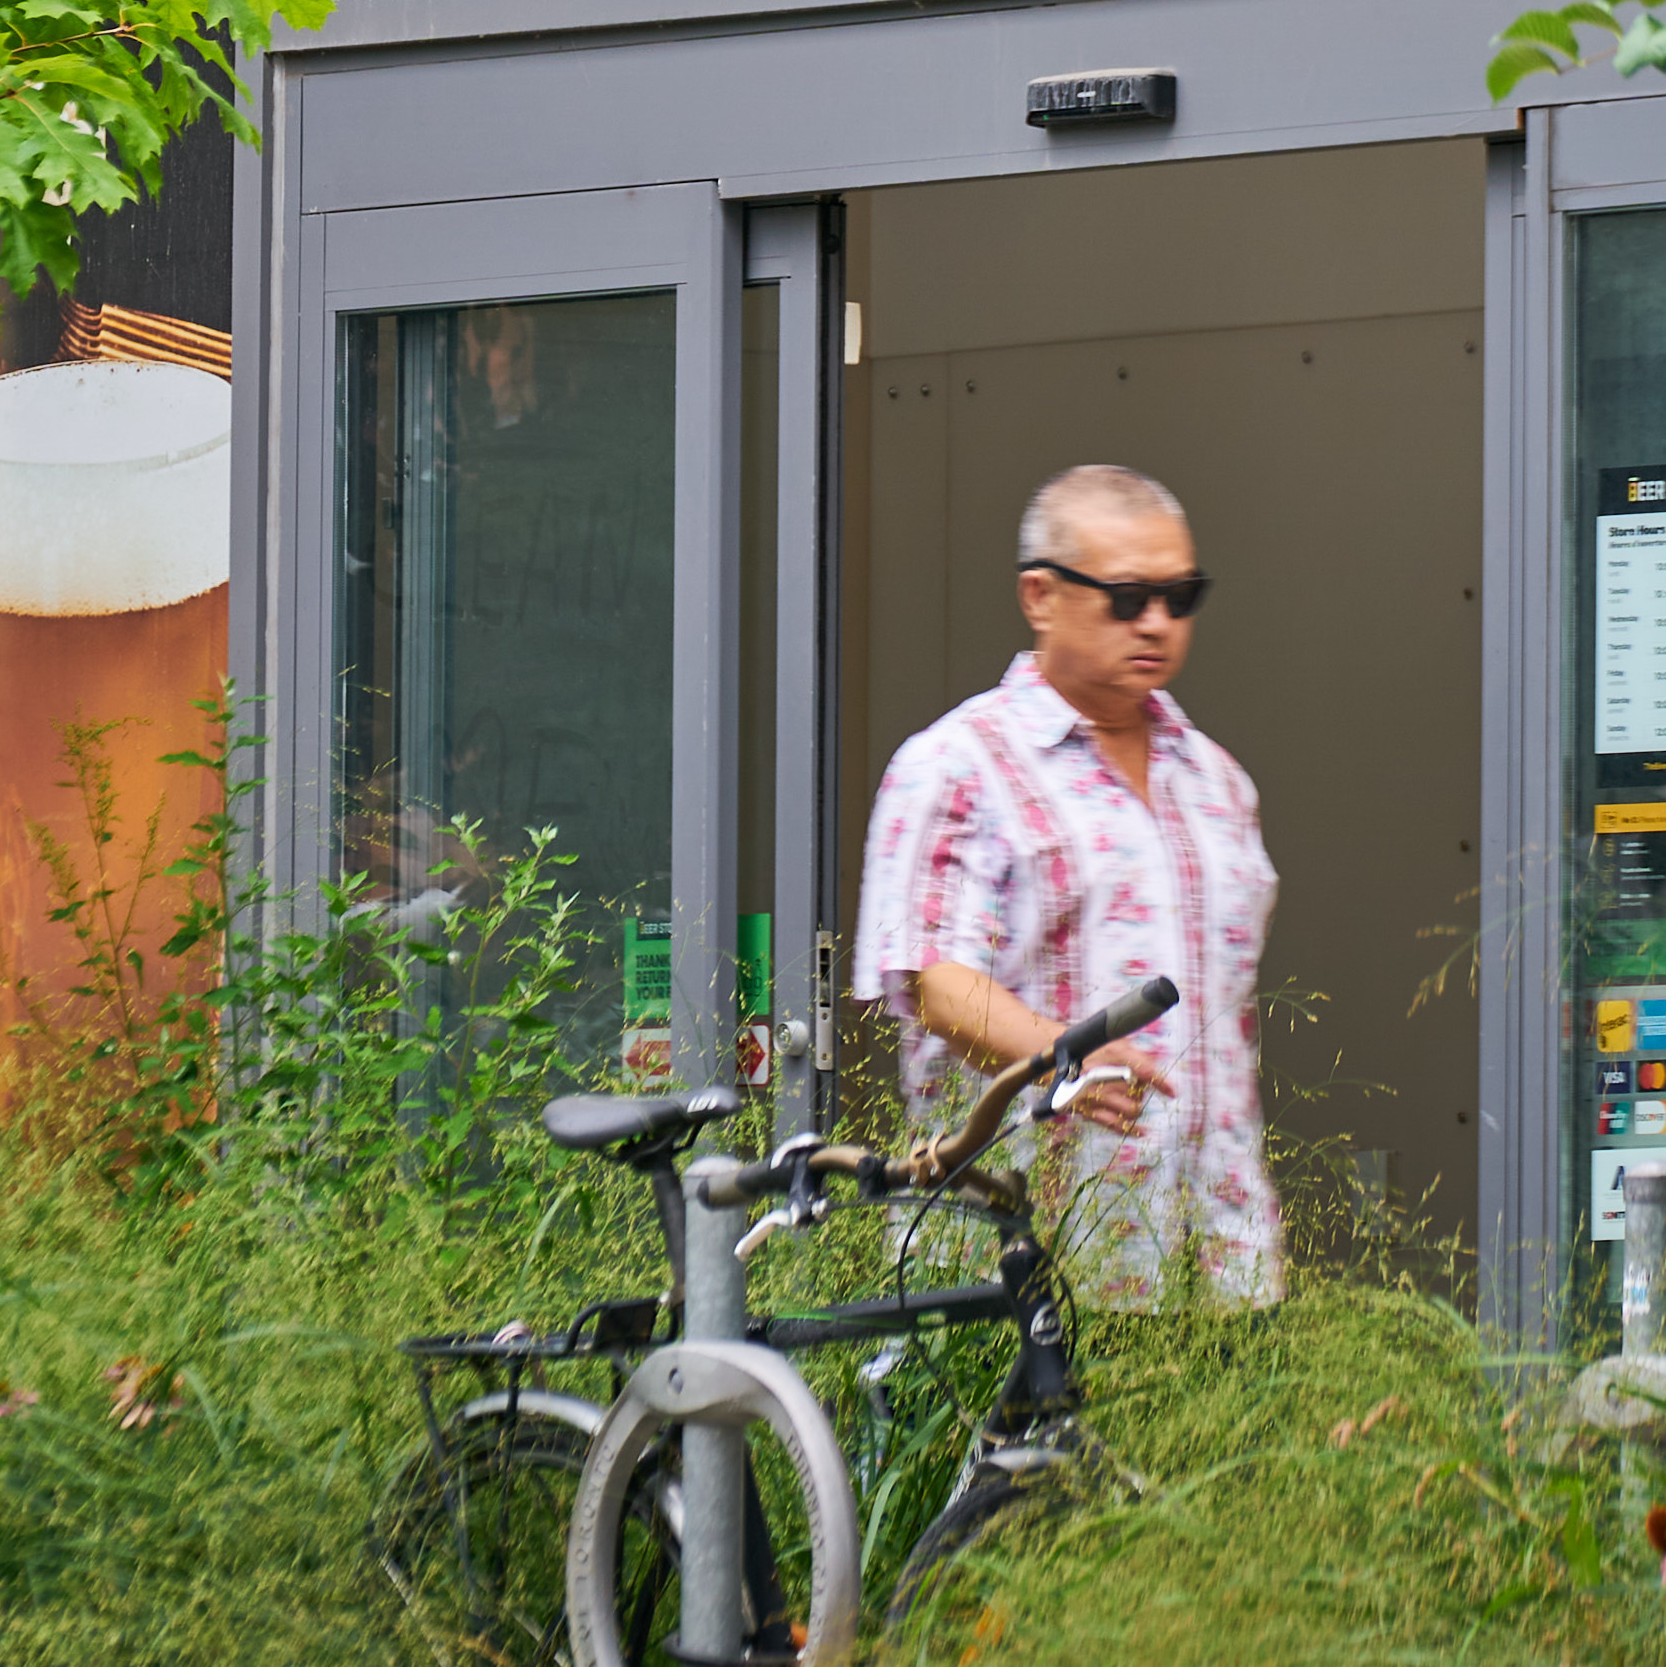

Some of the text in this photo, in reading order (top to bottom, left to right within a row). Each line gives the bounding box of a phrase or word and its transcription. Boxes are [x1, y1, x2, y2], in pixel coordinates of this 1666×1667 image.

[1627, 477, 1666, 502] BEER
[1608, 524, 1666, 537] Store Hours
[1603, 1071, 1626, 1084] VISA
